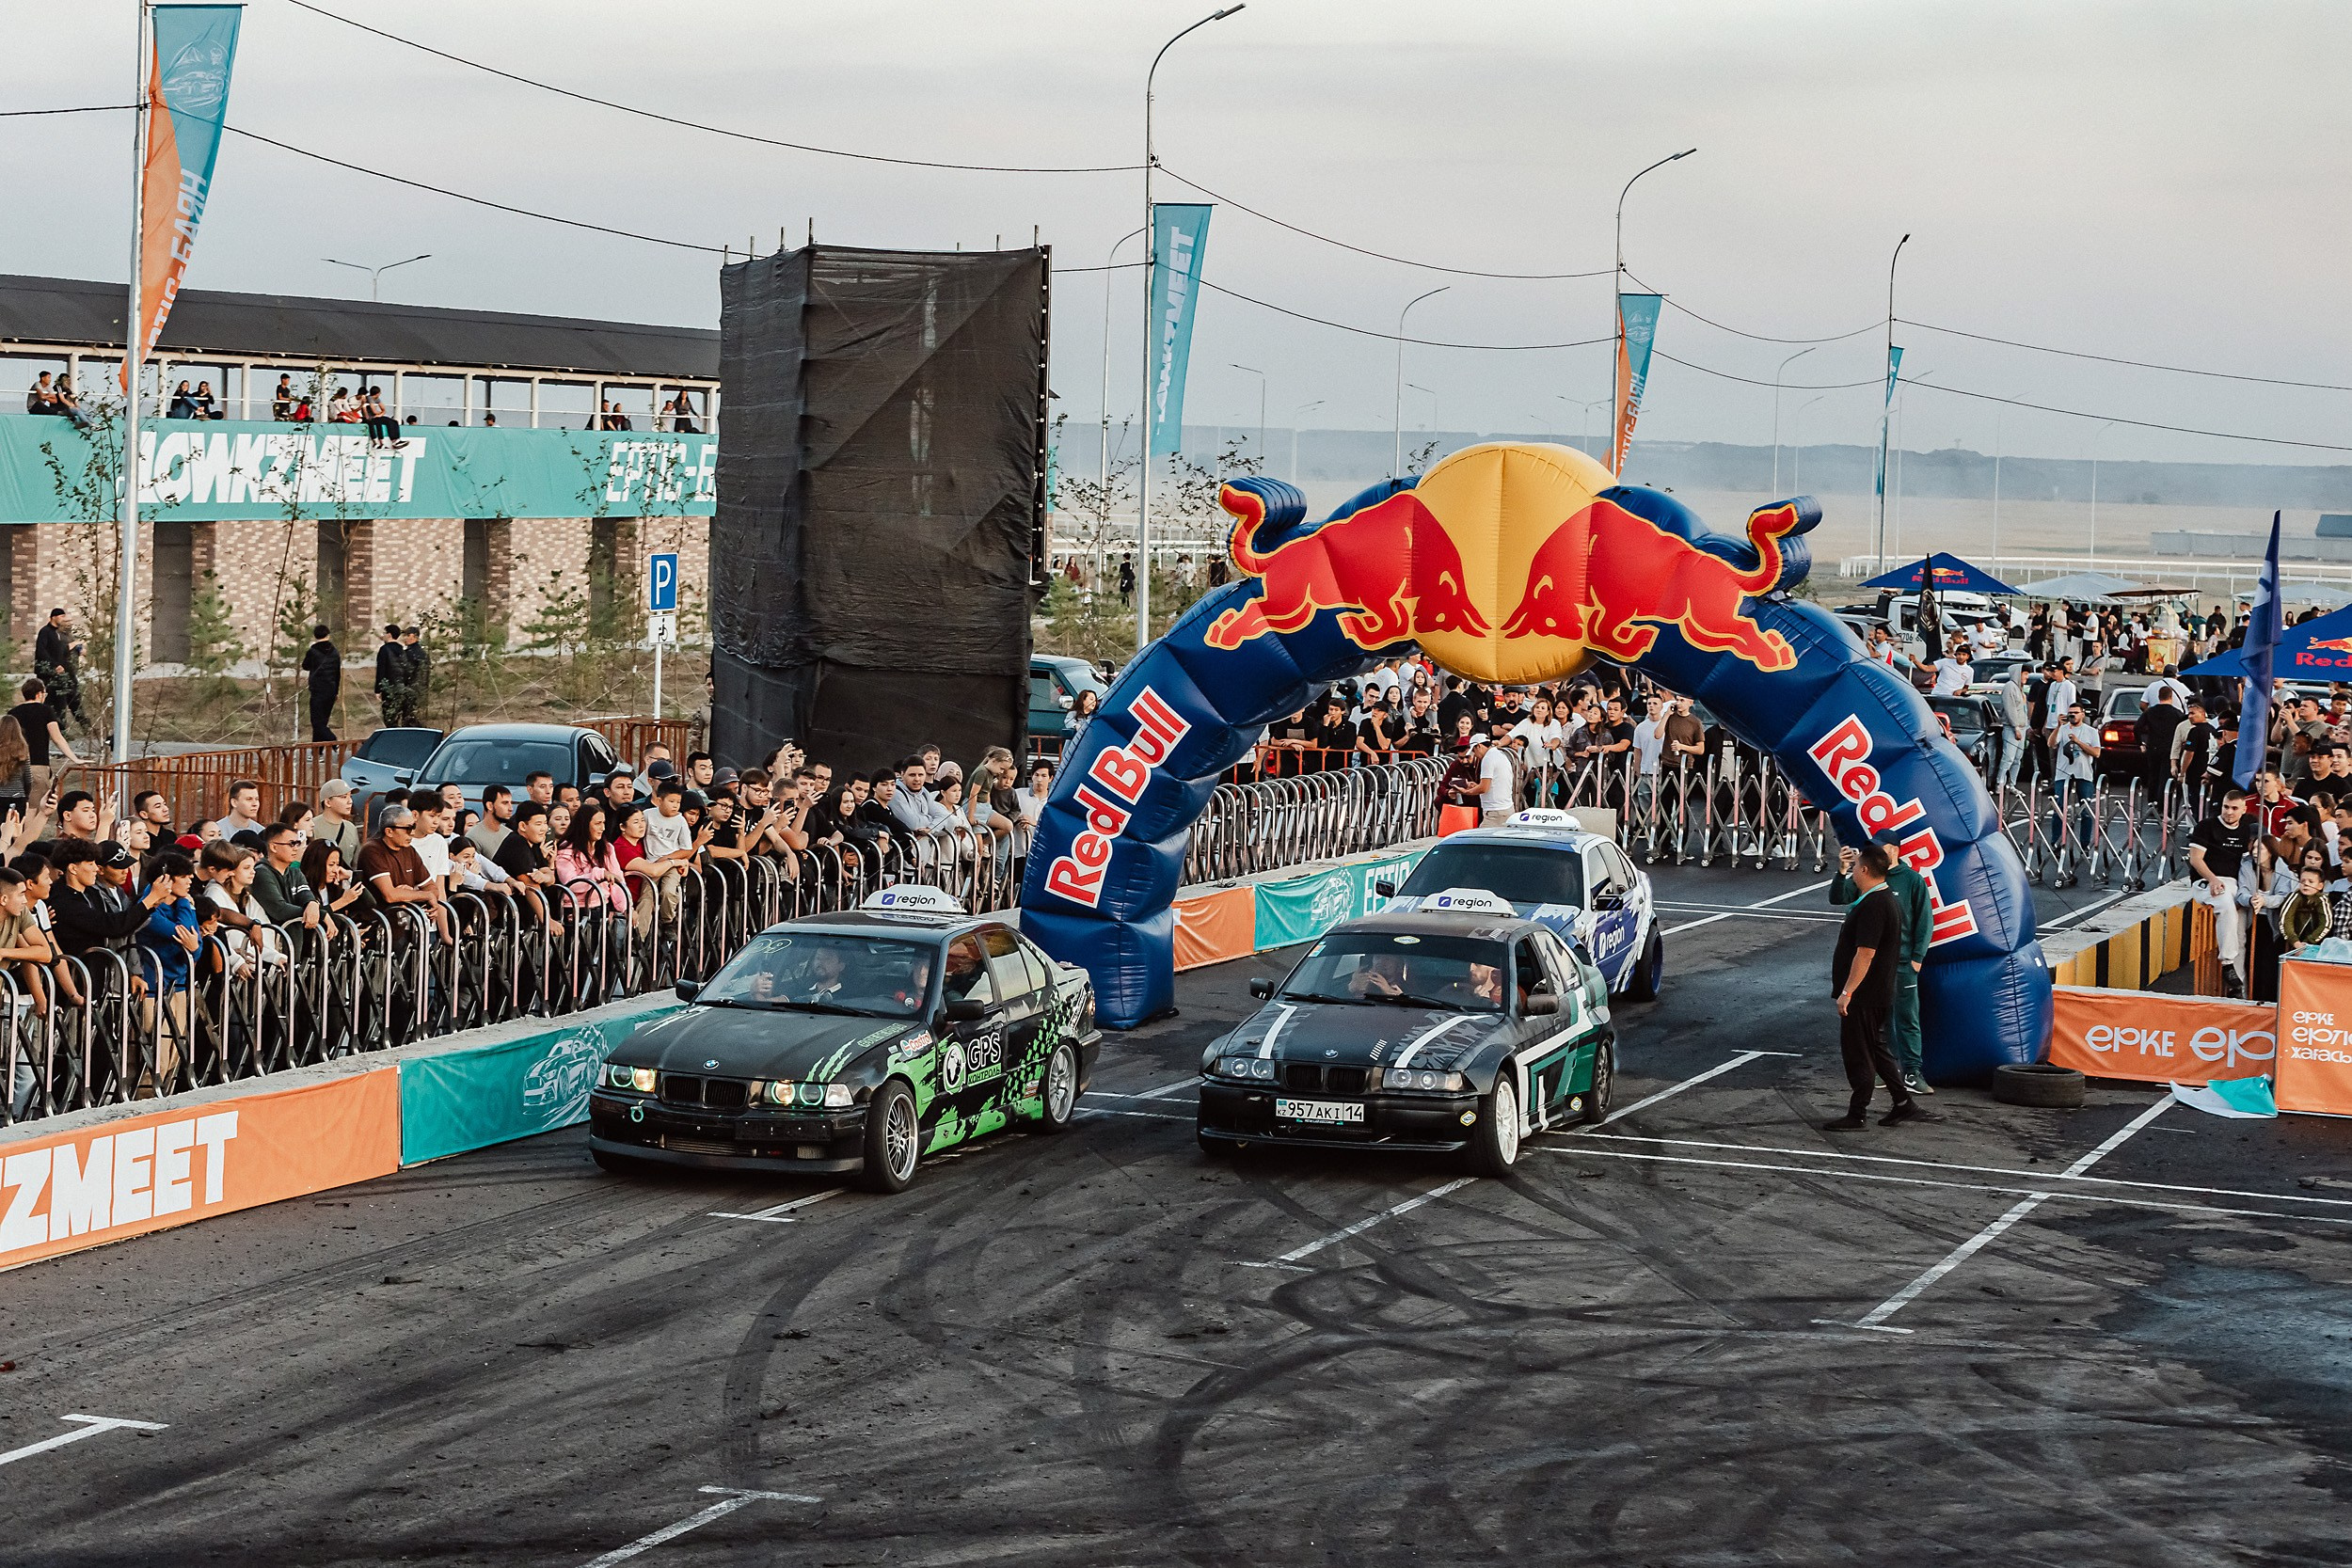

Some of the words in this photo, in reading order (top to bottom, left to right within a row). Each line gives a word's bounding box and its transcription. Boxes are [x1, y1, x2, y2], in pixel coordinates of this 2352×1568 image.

[116, 431, 426, 503] LOWKZMEET
[605, 441, 717, 502] ЕРТІС-Б
[656, 560, 672, 605] P
[2296, 652, 2352, 668] Red
[1046, 786, 1129, 907] Red
[1089, 689, 1187, 802] Bull
[1532, 814, 1563, 823] region
[1810, 717, 1924, 838] Red
[1899, 830, 1975, 945] Bll
[897, 895, 936, 907] region
[1453, 898, 1492, 909] region
[1606, 924, 1625, 954] region
[909, 1030, 932, 1051] Castrol
[967, 1032, 1001, 1070] GPS
[1345, 1105, 1362, 1120] 14
[0, 1111, 239, 1254] ZMEET
